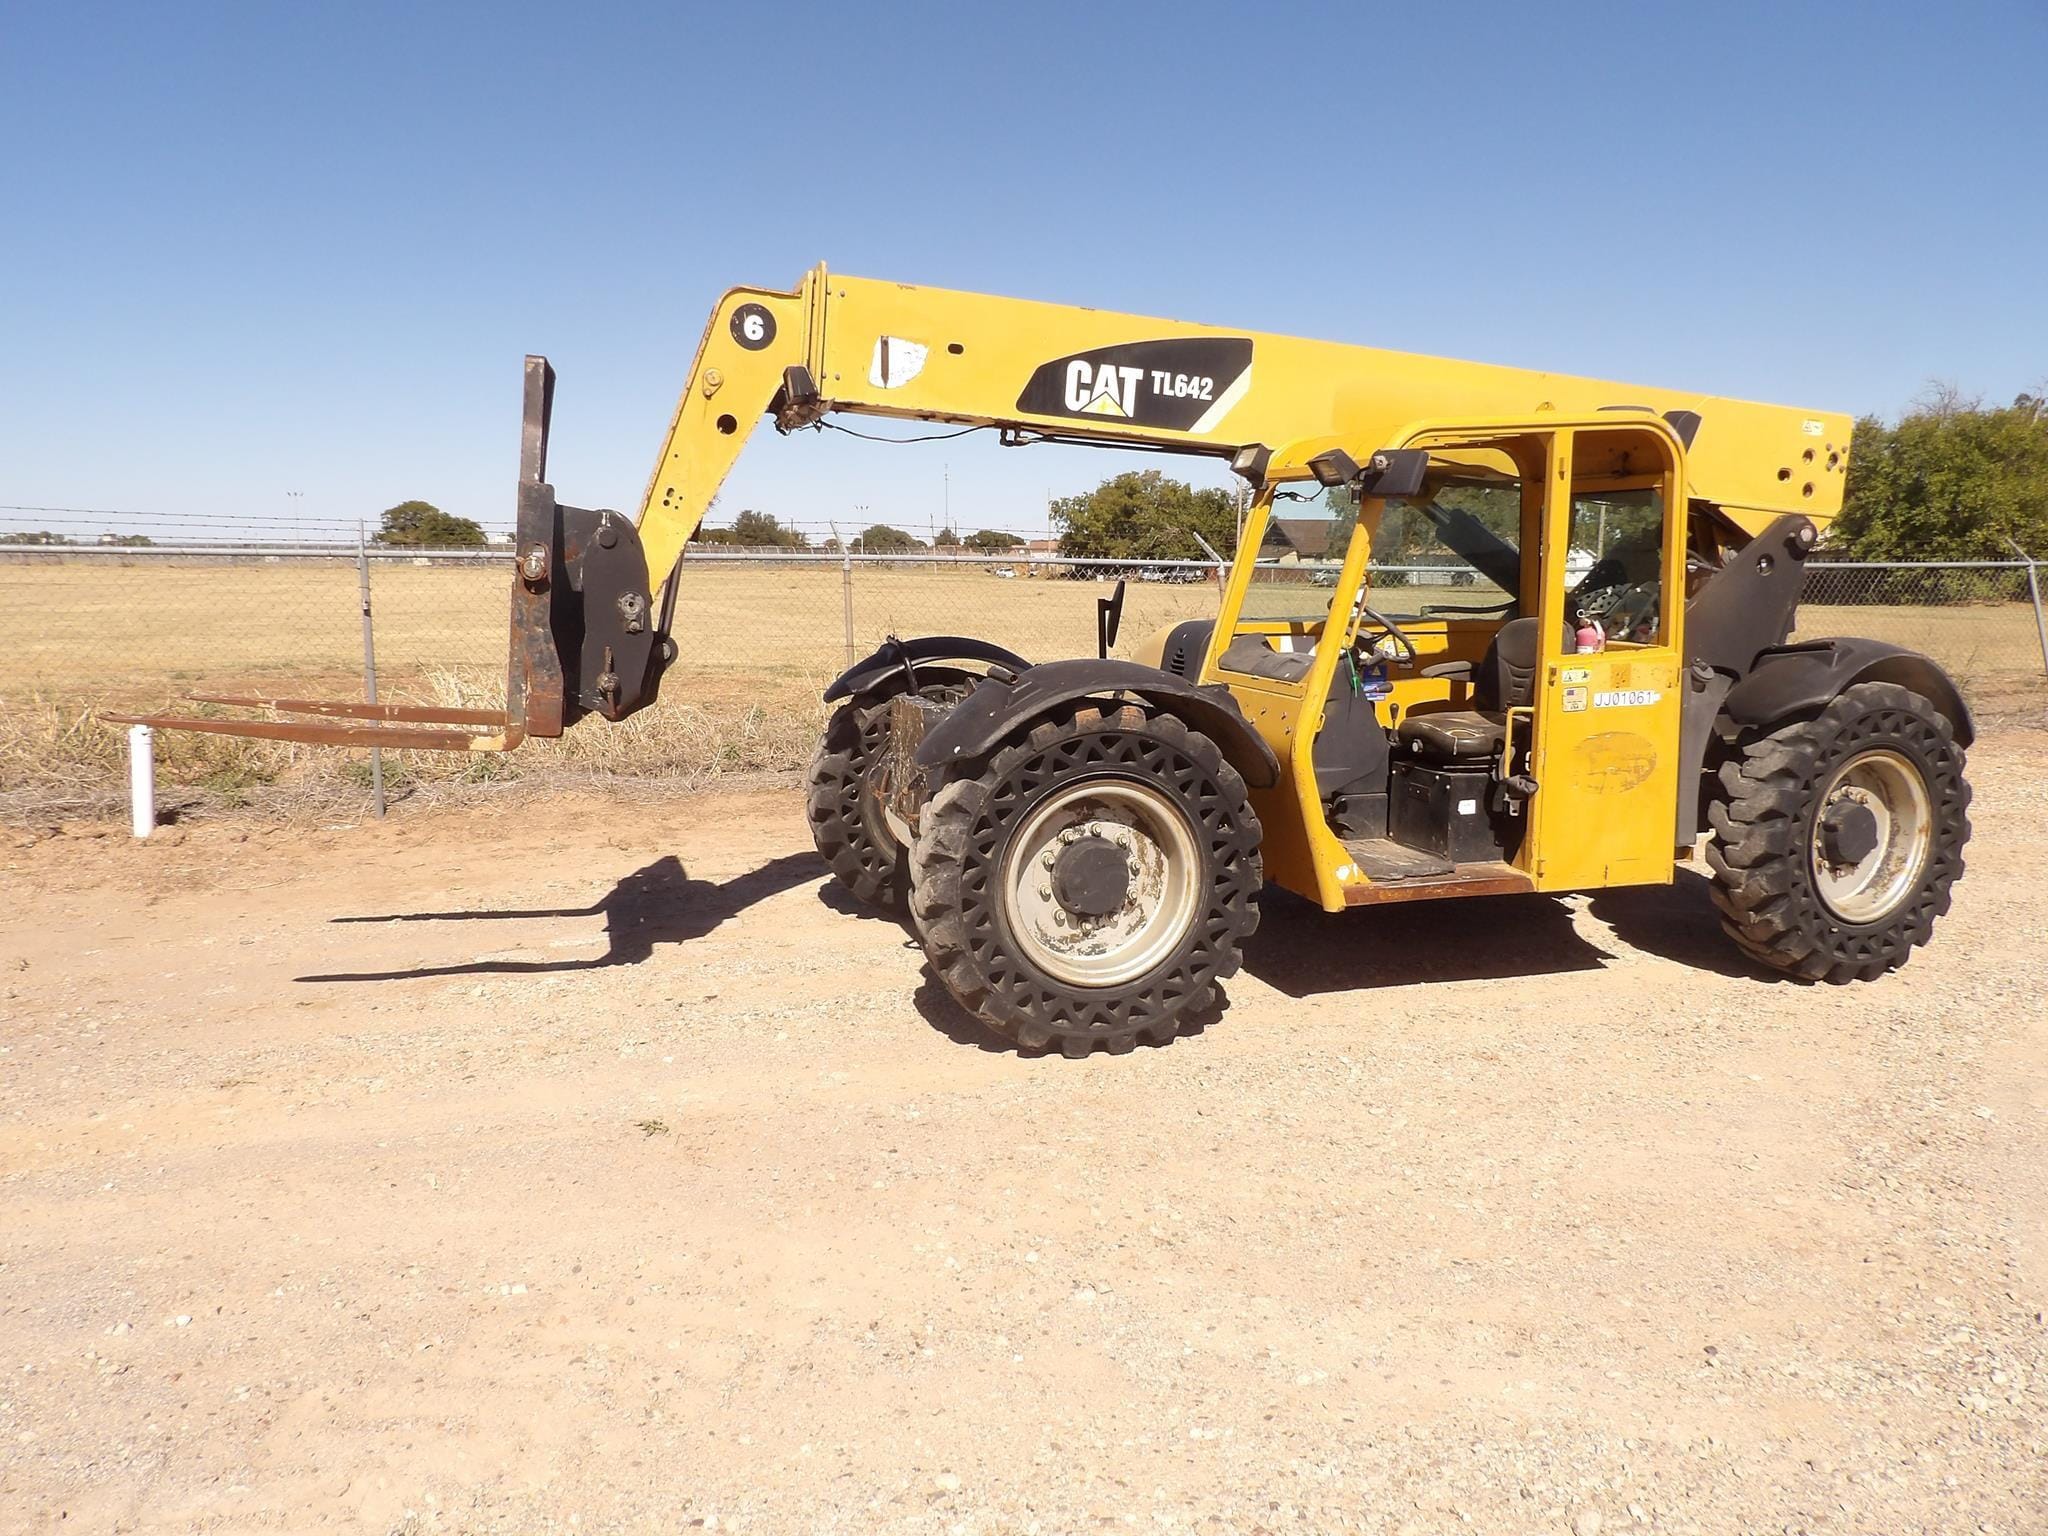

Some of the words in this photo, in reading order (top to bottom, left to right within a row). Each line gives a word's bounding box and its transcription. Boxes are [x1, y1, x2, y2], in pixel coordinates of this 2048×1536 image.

[743, 314, 764, 341] 6
[1065, 360, 1144, 418] CAT
[1151, 370, 1214, 401] TL642
[1595, 691, 1652, 707] JJ01061
